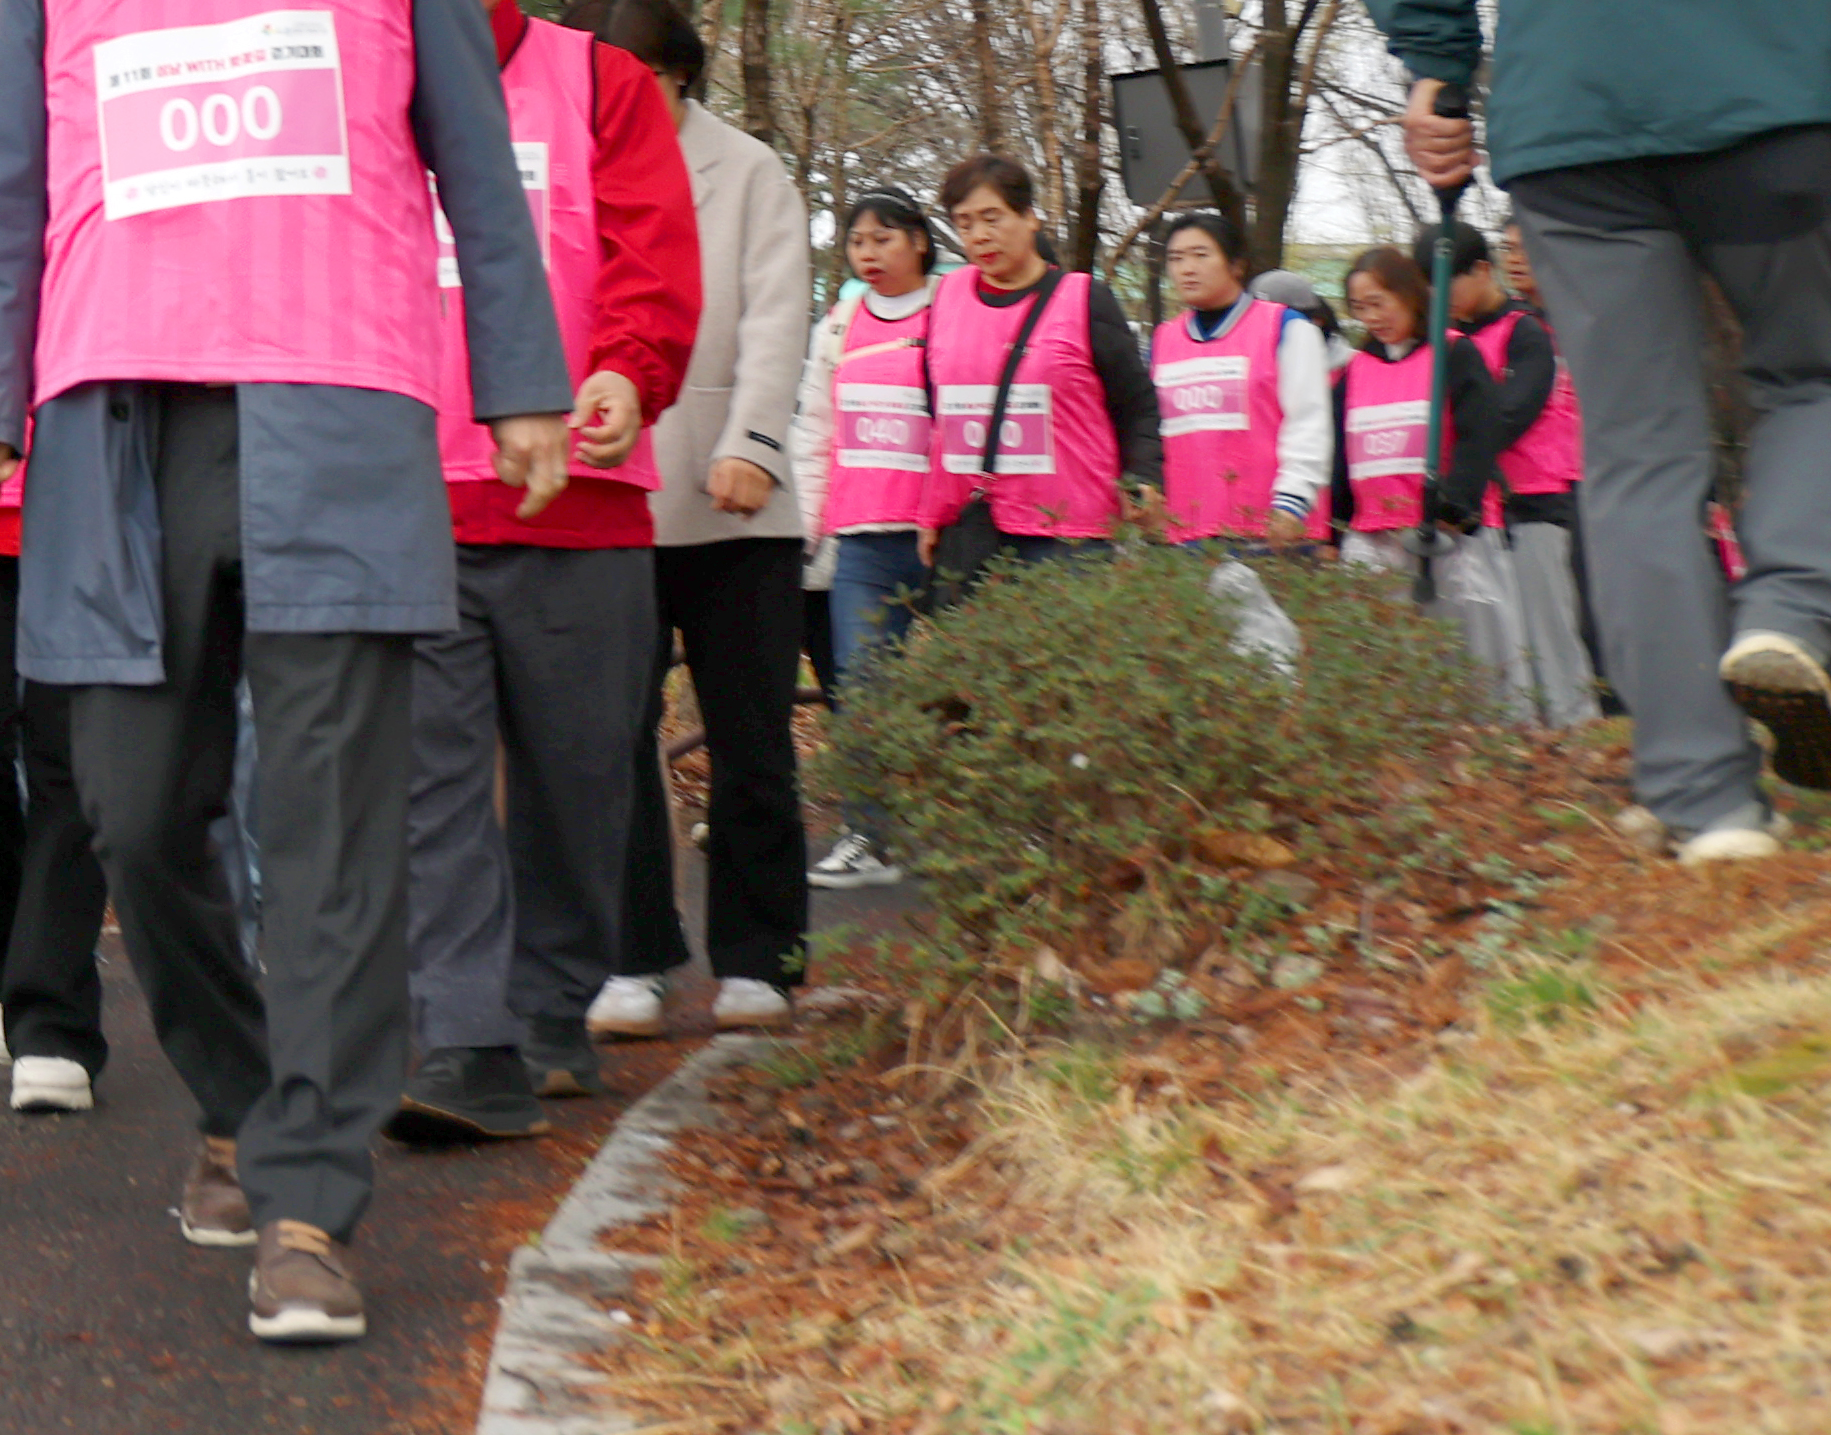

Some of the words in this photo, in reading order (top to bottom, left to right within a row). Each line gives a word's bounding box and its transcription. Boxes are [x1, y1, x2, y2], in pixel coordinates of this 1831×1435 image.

[186, 58, 226, 74] WITH
[160, 85, 283, 152] 000
[962, 419, 1024, 449] 00
